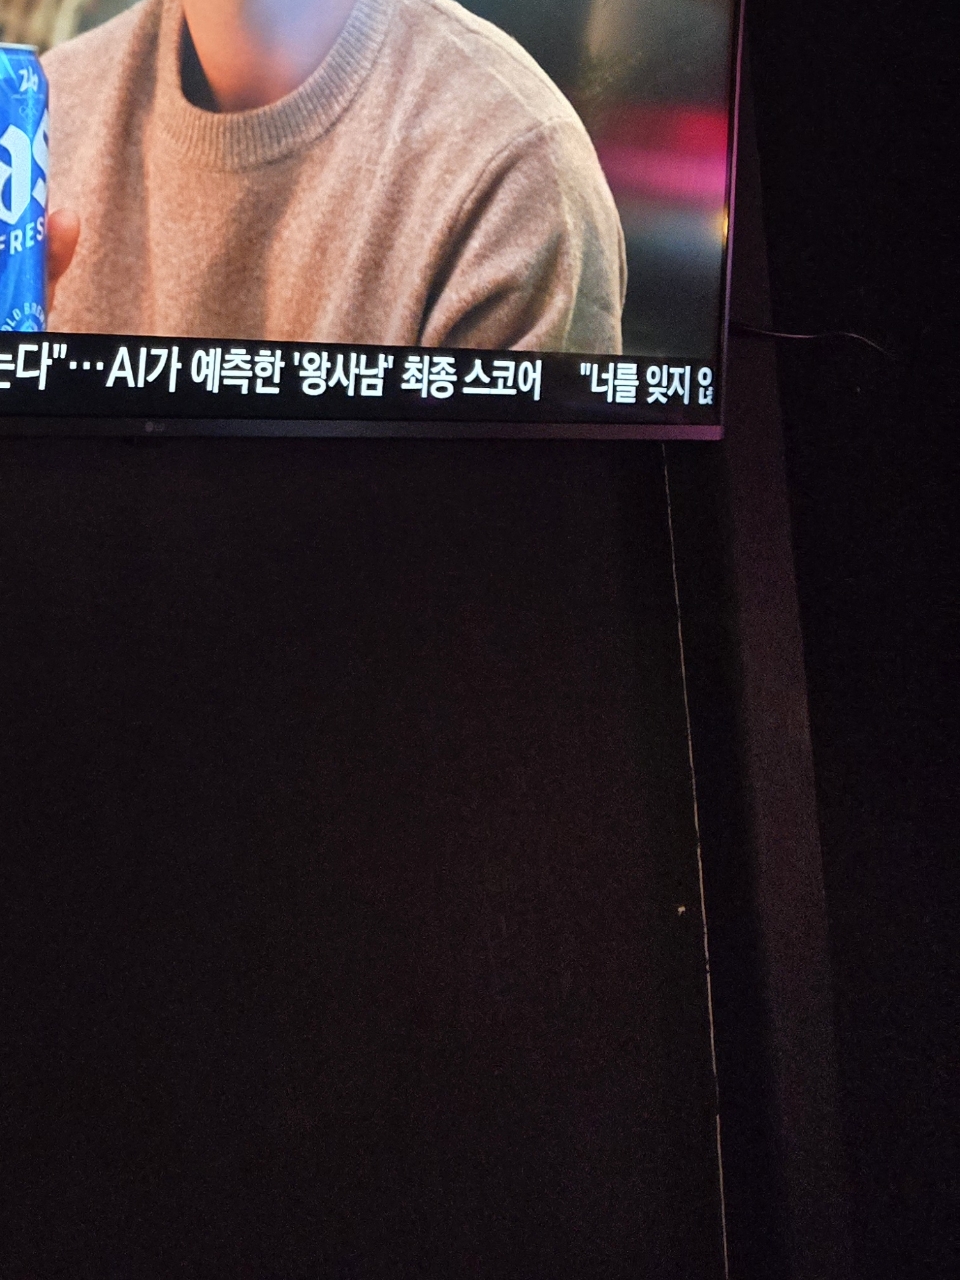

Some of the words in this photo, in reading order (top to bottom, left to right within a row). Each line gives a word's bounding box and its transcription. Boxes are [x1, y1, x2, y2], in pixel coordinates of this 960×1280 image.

[190, 347, 286, 395] 예측한
[293, 350, 395, 397] '왕사남'
[400, 355, 458, 399] 최종
[462, 359, 543, 401] 스코어
[580, 362, 640, 404] "너를
[646, 364, 692, 405] 잊지
